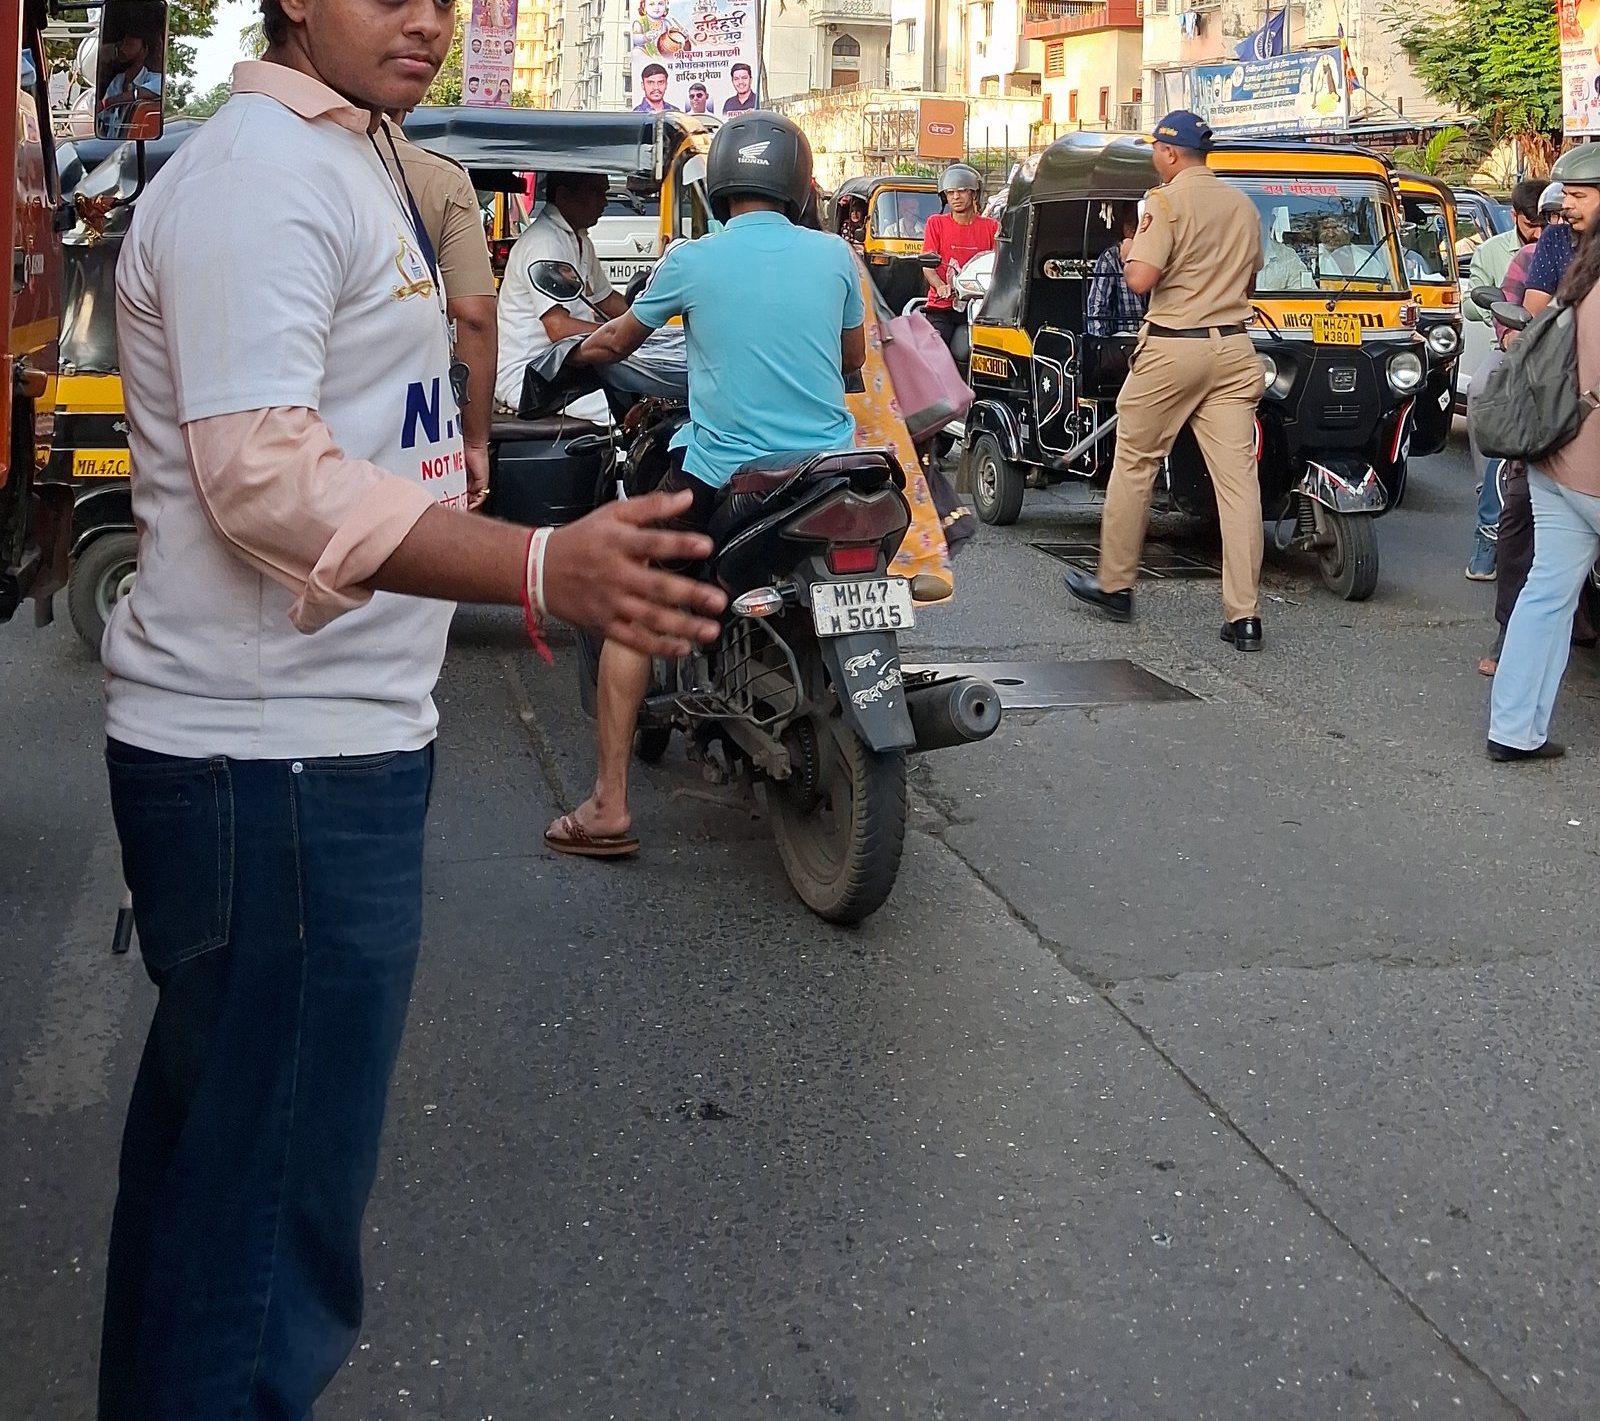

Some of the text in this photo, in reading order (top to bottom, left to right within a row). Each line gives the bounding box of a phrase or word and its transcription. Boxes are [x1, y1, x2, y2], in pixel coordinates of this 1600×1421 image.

[675, 70, 697, 82] हार्दिक
[738, 157, 770, 166] HONDA
[421, 455, 450, 481] NOT
[833, 581, 889, 607] MH 47
[847, 604, 902, 631] 5015
